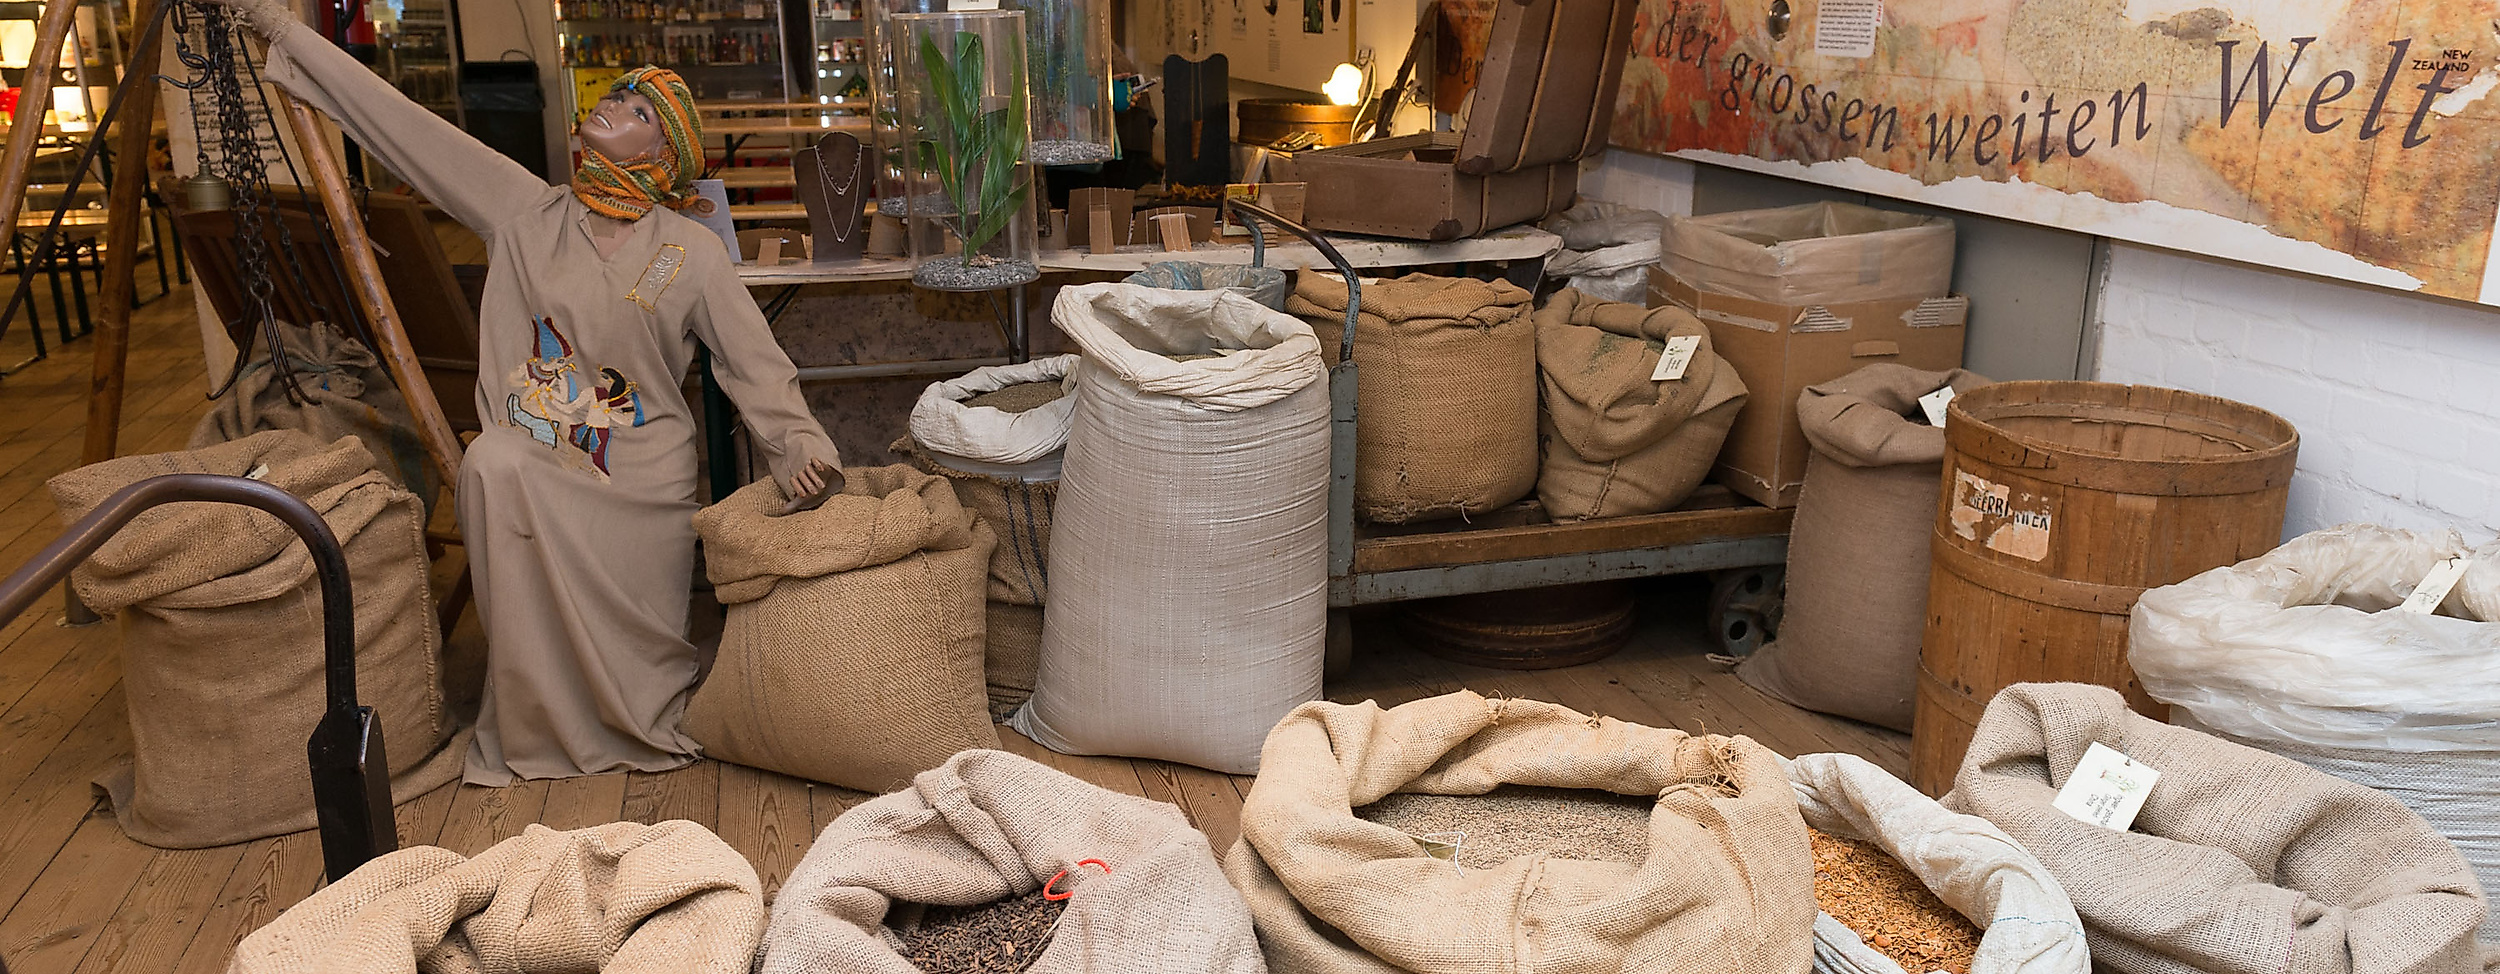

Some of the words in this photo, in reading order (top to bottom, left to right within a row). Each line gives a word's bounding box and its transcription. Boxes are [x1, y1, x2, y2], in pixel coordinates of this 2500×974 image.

[2442, 49, 2473, 60] NEW
[2412, 59, 2470, 72] ZEALAND
[1656, 0, 1718, 68] der
[1721, 49, 1898, 152] grossen
[1926, 82, 2153, 166] weiten
[2214, 36, 2456, 150] Welt
